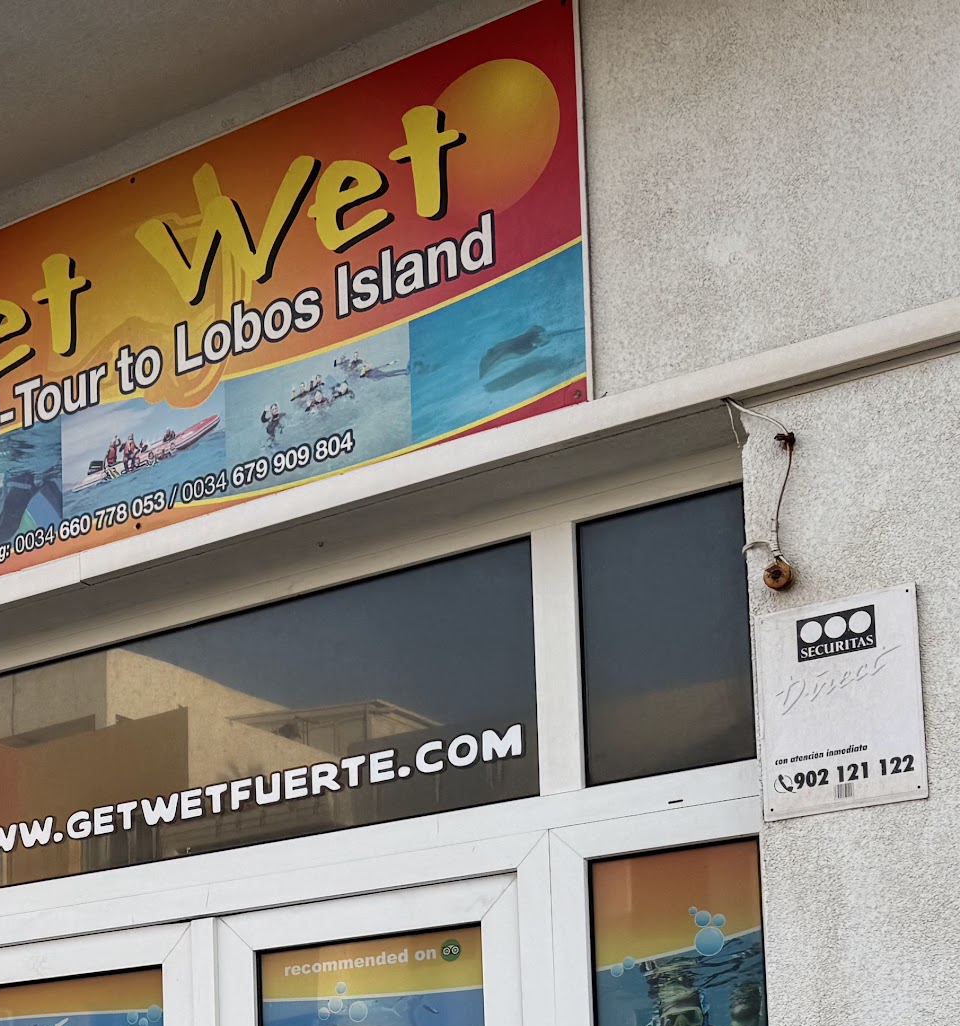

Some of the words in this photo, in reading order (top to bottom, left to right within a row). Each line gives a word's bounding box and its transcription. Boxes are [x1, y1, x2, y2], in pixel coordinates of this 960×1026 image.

[135, 104, 466, 305] Wet
[115, 341, 163, 397] to
[174, 298, 323, 378] Lobos
[336, 212, 496, 320] Island
[14, 525, 56, 556] 0034
[58, 514, 91, 541] 660
[96, 503, 128, 531] 778
[131, 490, 166, 520] 053
[169, 485, 179, 509] /
[181, 475, 227, 505] 0034
[231, 458, 268, 487] 679
[273, 446, 309, 476] 909
[314, 432, 355, 464] 804
[800, 634, 874, 660] SECURITAS
[775, 756, 788, 766] con
[826, 744, 868, 758] inmediata
[794, 768, 829, 790] 902
[836, 761, 869, 782] 121
[879, 754, 915, 776] 122
[284, 948, 409, 977] recommended
[414, 947, 437, 962] on
